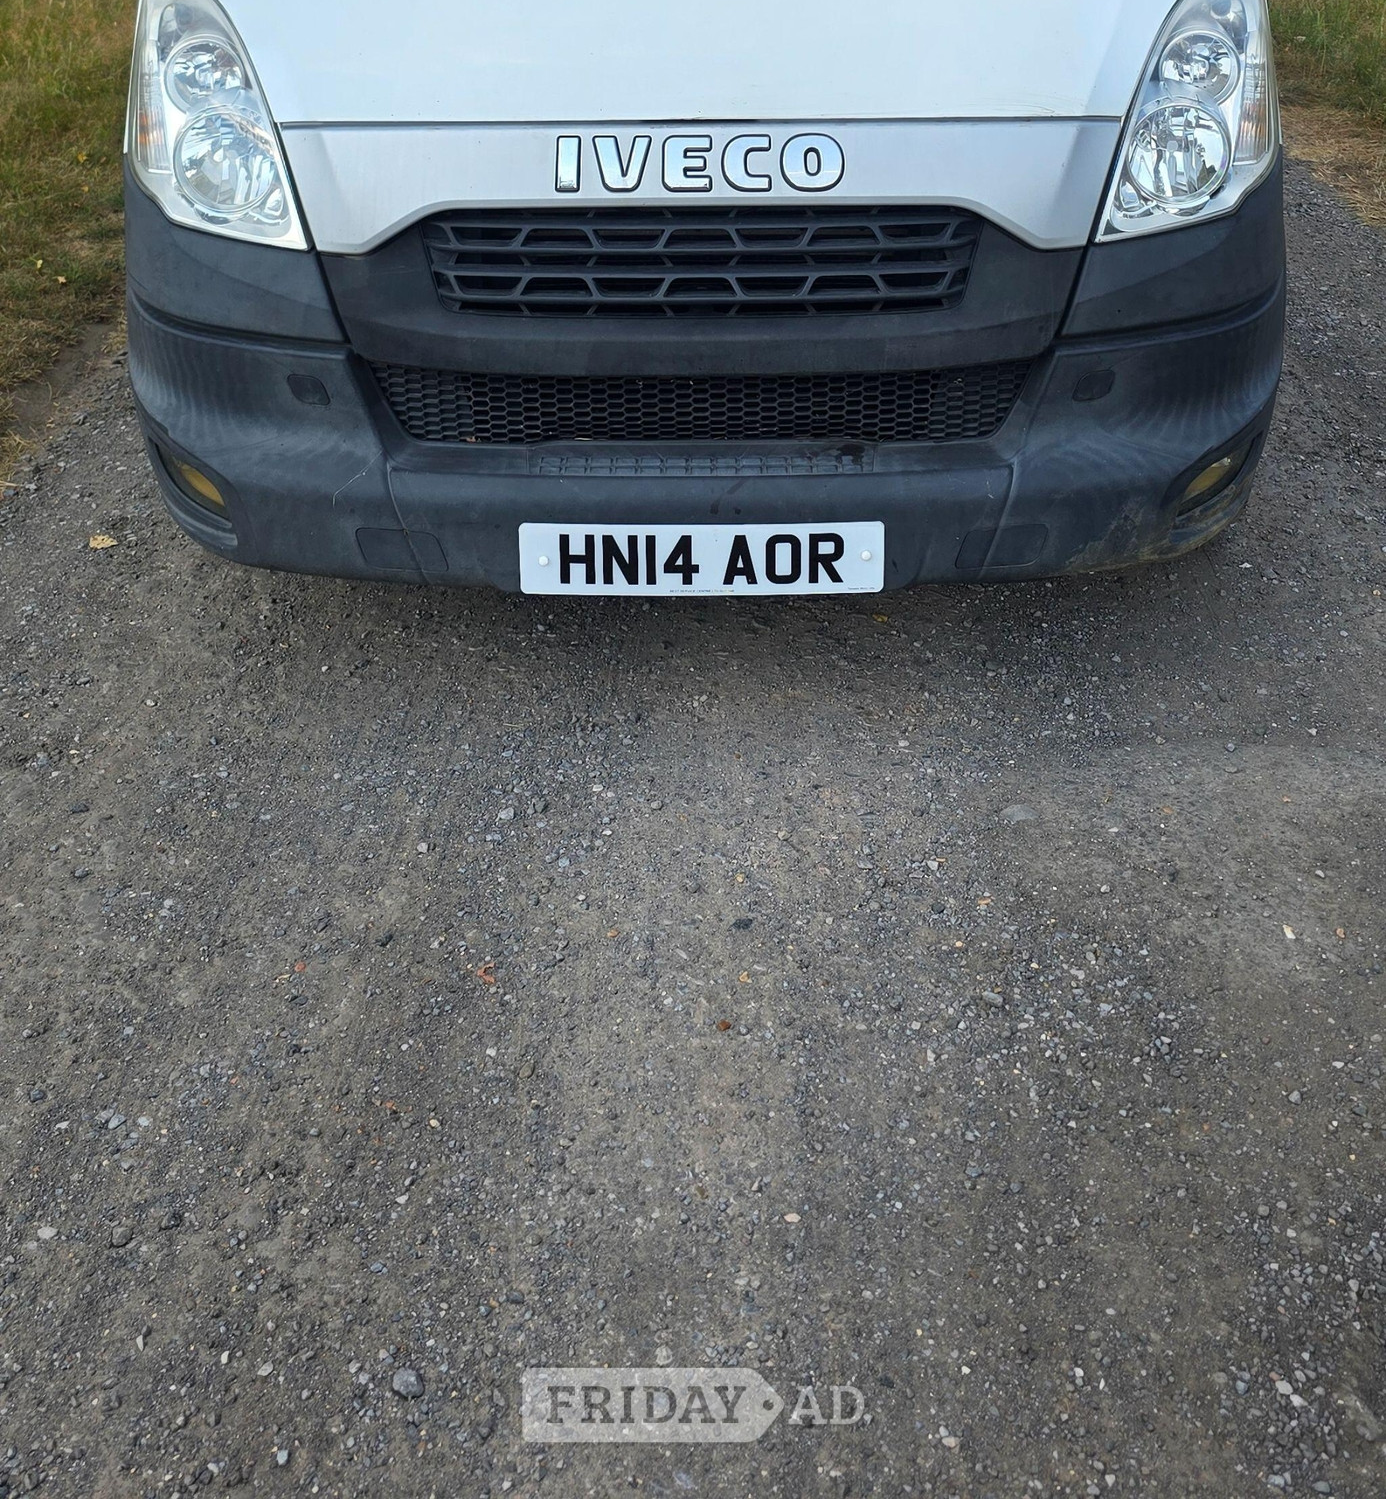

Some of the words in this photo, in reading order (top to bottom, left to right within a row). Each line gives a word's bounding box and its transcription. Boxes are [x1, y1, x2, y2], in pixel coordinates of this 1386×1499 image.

[554, 133, 845, 192] IVECO
[559, 533, 700, 585] HN14
[723, 532, 845, 585] AOR
